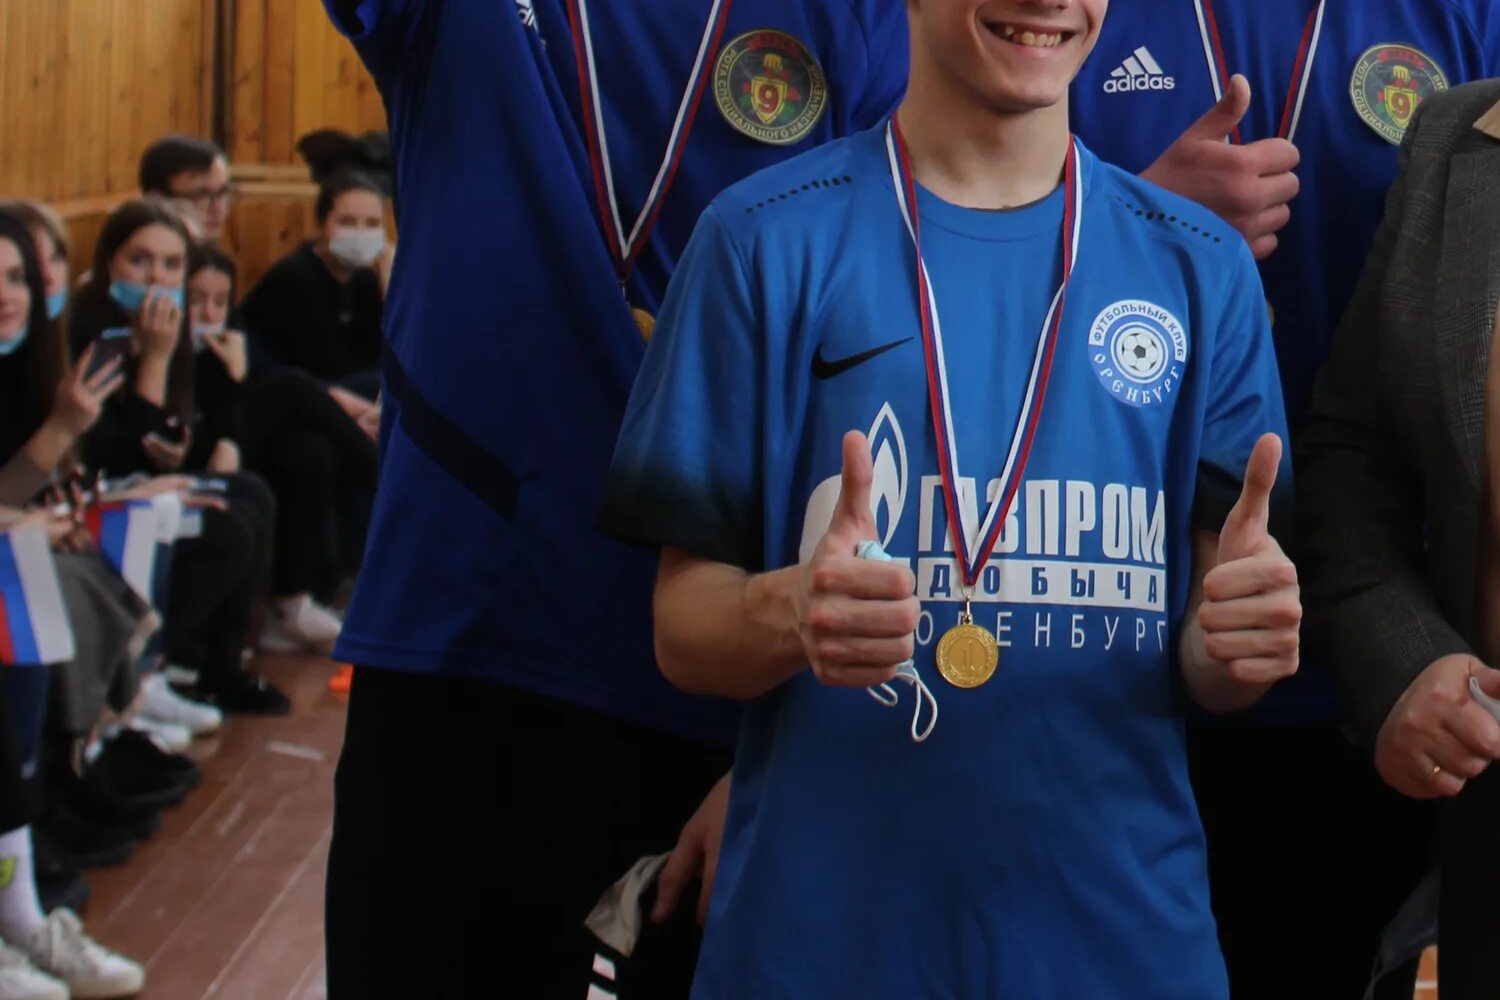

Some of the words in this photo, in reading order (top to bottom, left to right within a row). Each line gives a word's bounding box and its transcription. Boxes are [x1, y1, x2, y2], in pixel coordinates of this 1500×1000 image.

[717, 49, 737, 80] РОТА
[1353, 60, 1369, 87] РОТА
[758, 84, 780, 114] 9
[1103, 73, 1175, 93] adidas
[717, 81, 789, 138] СПЕЦИАЛЬНОГО
[1391, 93, 1411, 120] 9
[1094, 304, 1168, 341] ФУТБОЛЬНЫЙ
[1168, 322, 1184, 357] КЛУБ
[1094, 353, 1180, 404] ОРЕНБУРГ
[918, 475, 1165, 565] ГАЗПРОМ
[929, 564, 1157, 603] ДОБЫЧА
